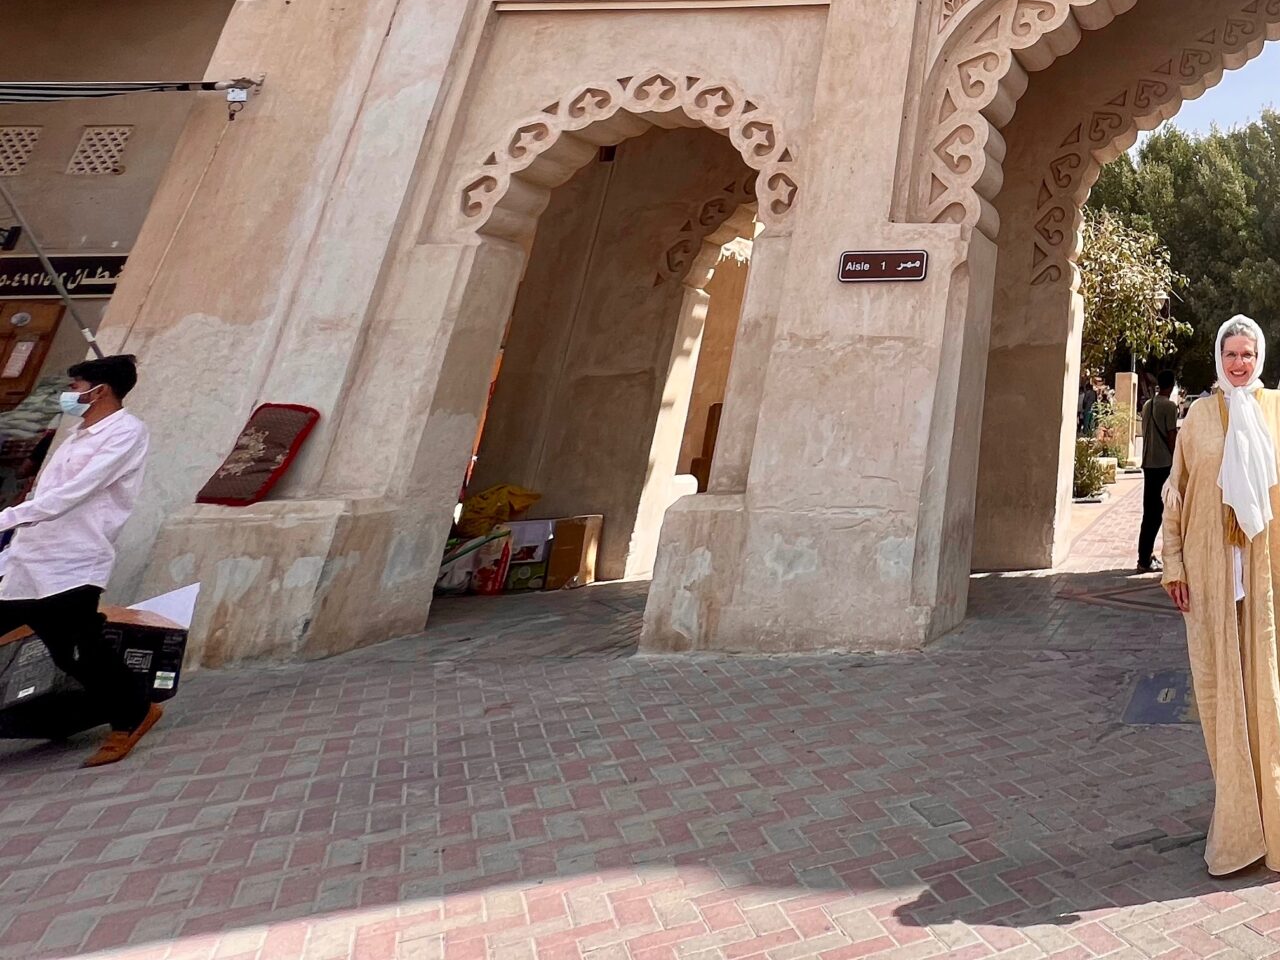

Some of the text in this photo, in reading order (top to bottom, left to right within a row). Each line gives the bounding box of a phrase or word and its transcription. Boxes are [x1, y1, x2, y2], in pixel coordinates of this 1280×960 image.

[845, 261, 886, 271] Aisle 1
[896, 260, 921, 271] ممر
